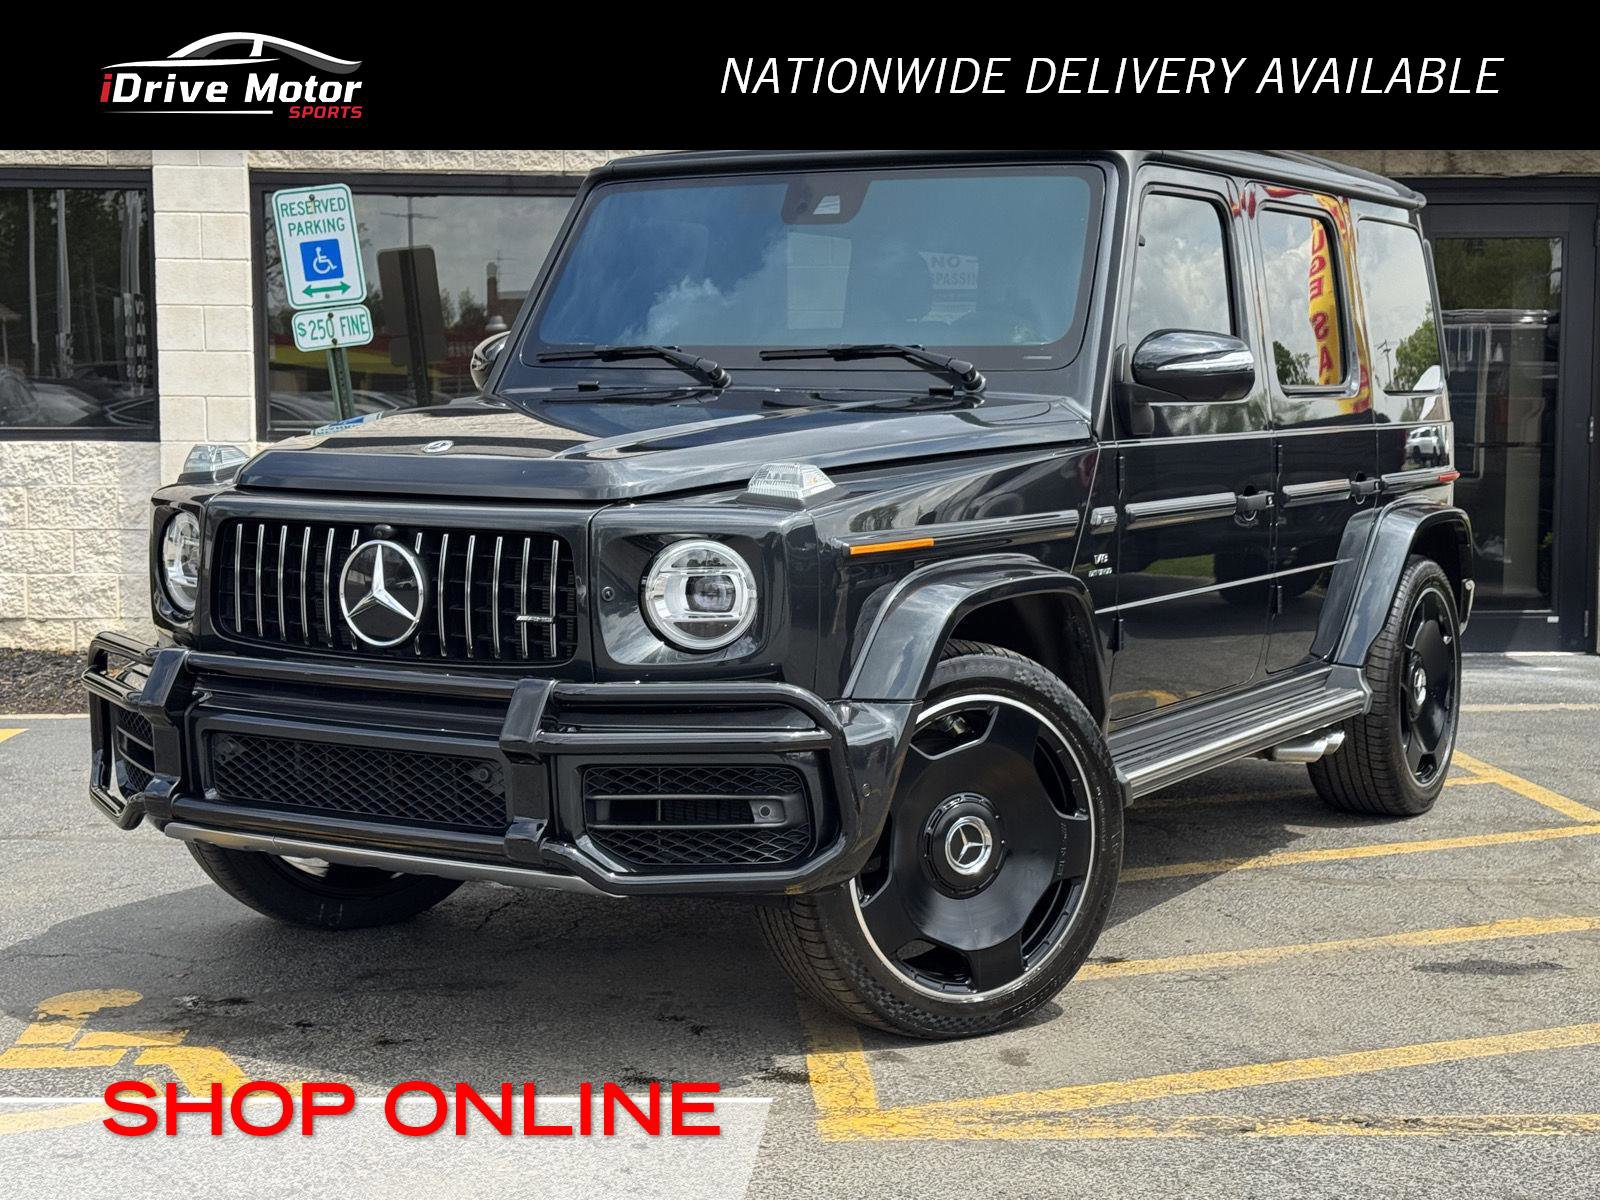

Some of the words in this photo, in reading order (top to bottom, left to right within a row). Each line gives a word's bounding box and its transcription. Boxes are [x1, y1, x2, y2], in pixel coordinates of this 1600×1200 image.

[280, 196, 347, 218] RESERVED
[287, 216, 345, 237] PARKING
[296, 317, 336, 341] $250
[339, 313, 369, 338] FINE
